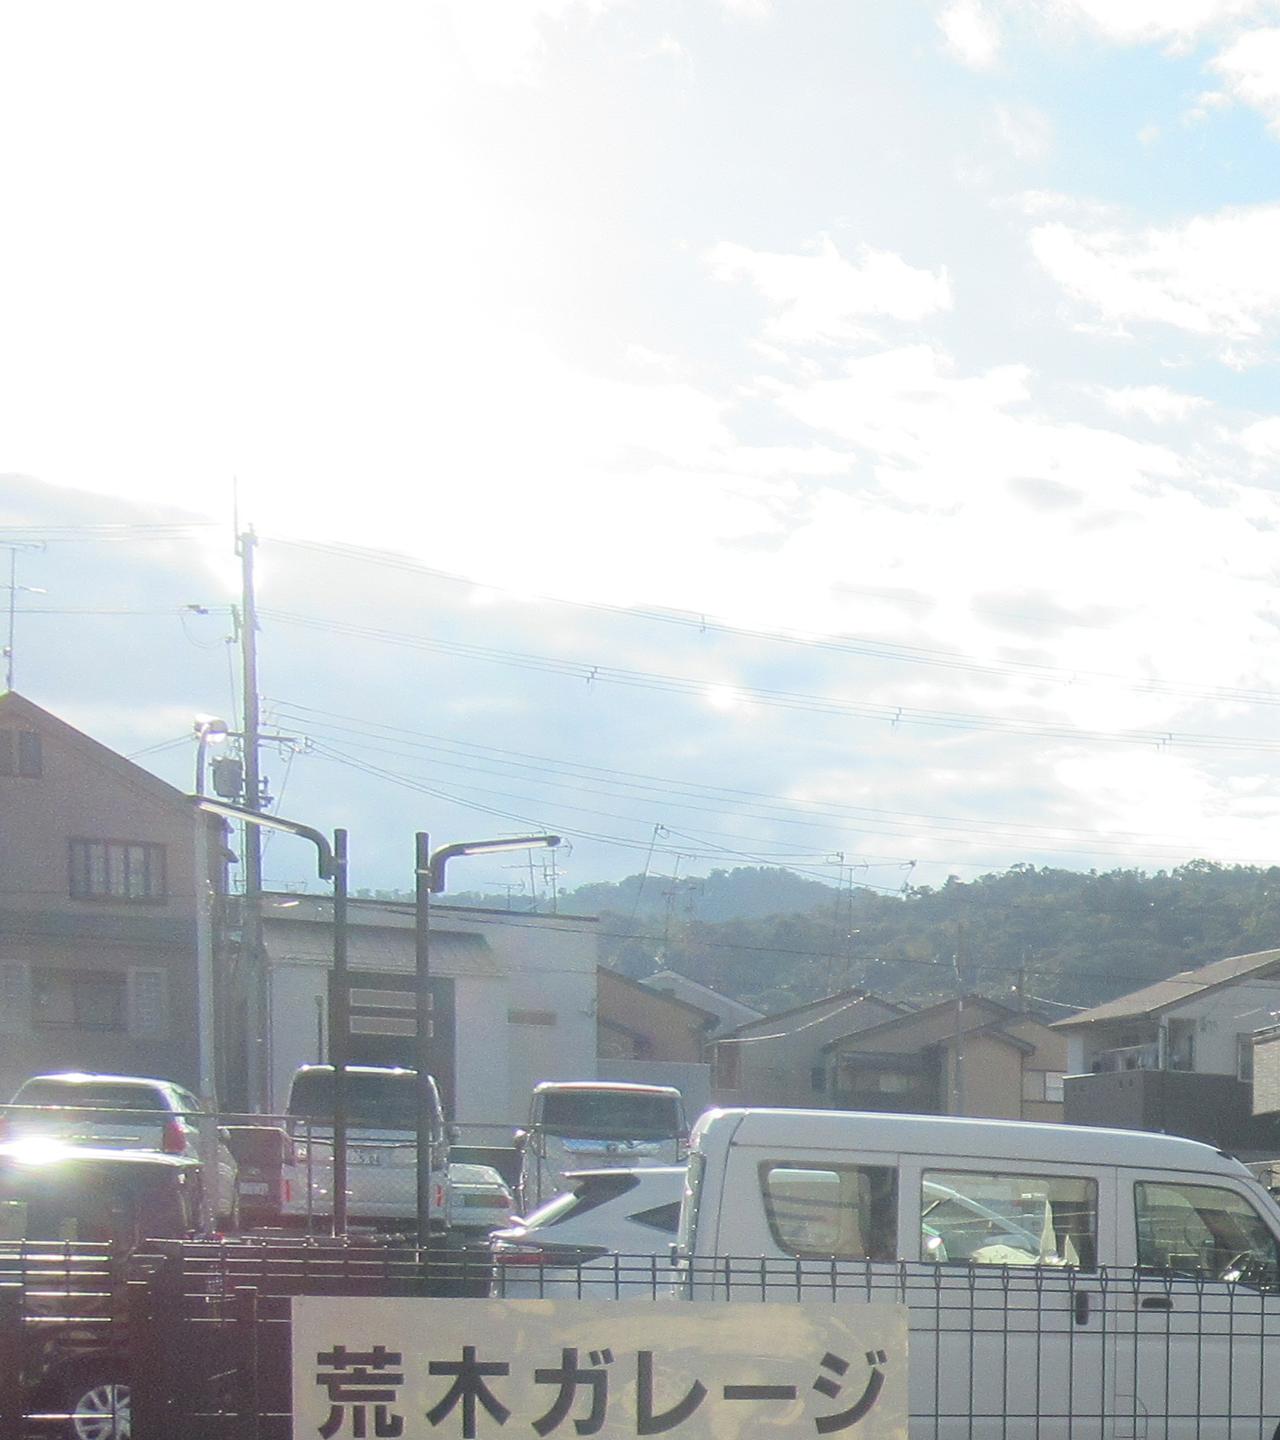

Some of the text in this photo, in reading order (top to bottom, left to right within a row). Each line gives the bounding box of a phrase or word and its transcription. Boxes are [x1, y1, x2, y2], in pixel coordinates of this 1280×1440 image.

[316, 1345, 889, 1439] 荒木ガレージ
